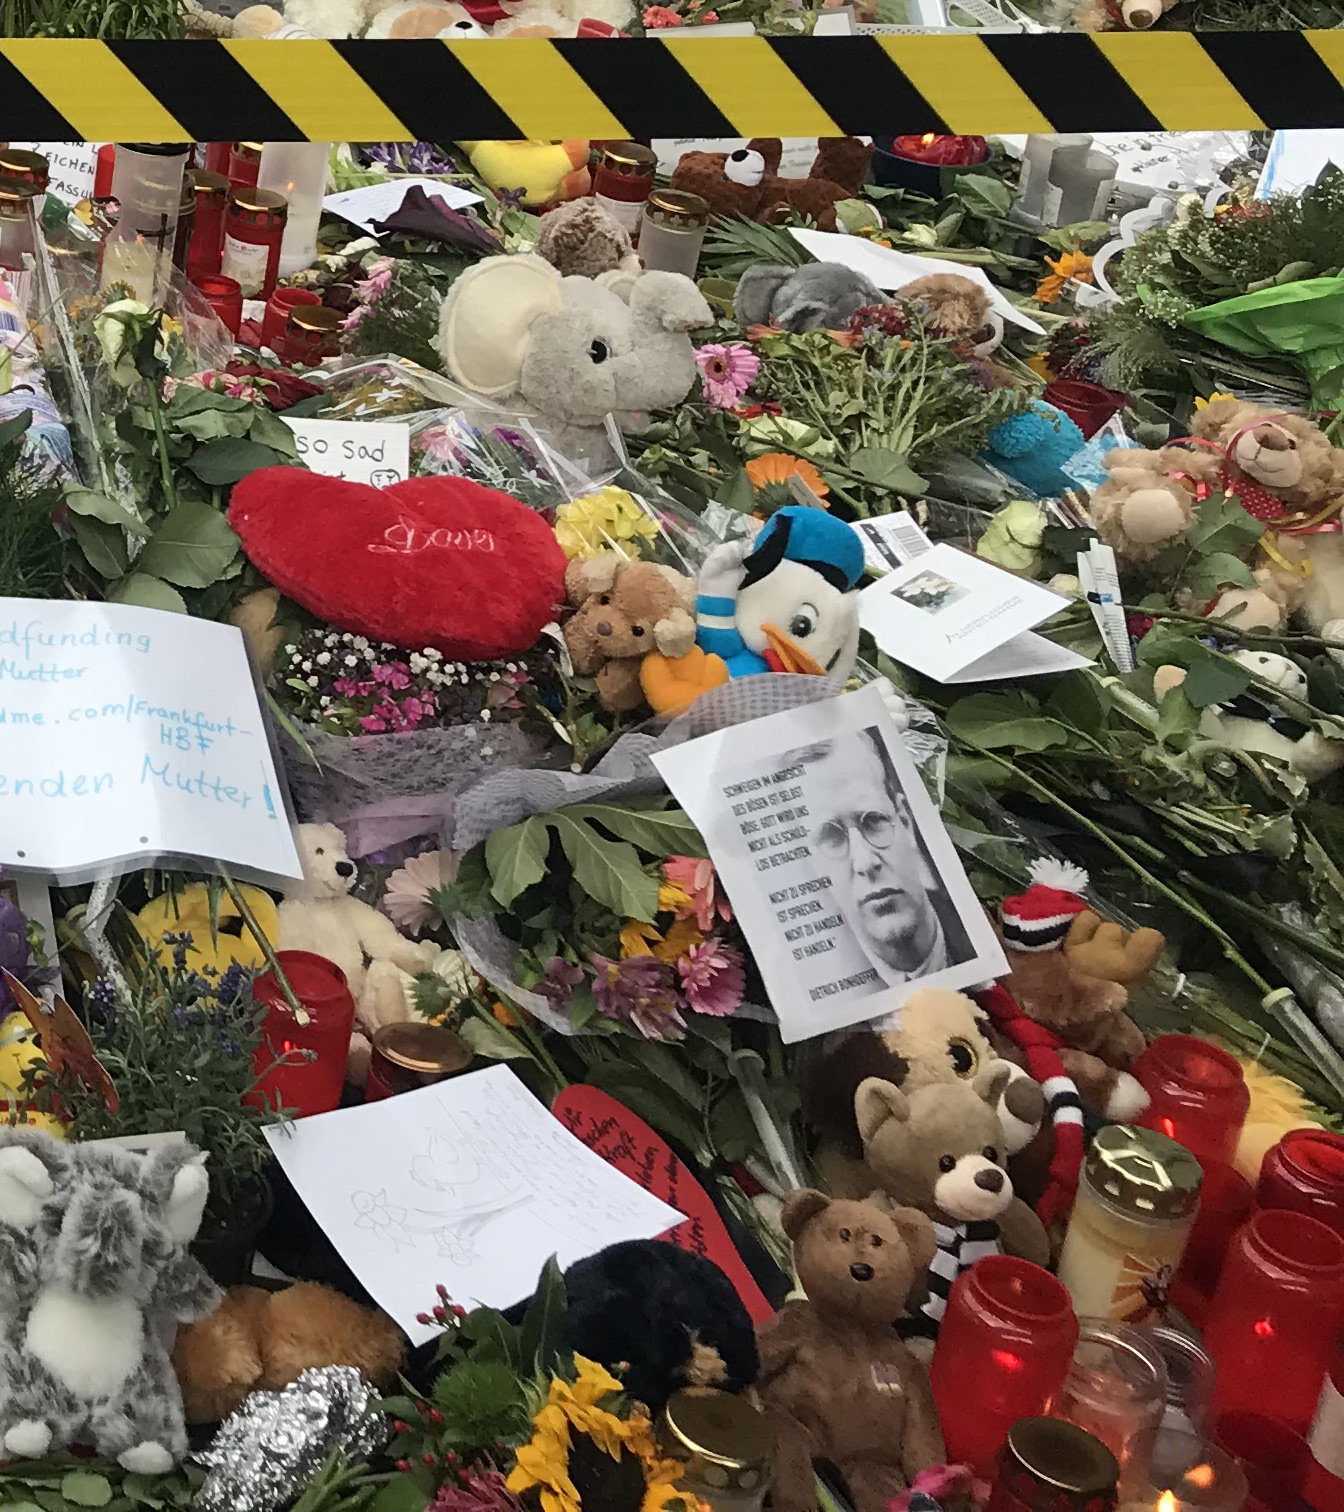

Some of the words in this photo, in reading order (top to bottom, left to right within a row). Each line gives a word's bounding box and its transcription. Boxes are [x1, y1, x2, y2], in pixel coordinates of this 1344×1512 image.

[723, 778, 762, 799] SCHWEIGEN
[771, 764, 807, 785] ANGESICHT
[731, 802, 747, 817] DES
[745, 797, 770, 813] BÖSEN
[768, 792, 781, 805] IST
[779, 786, 805, 803] SELBST
[759, 814, 778, 829] GOTT
[776, 809, 796, 824] WIRD
[794, 804, 810, 819] UNS
[747, 836, 769, 853] NICHT
[768, 833, 783, 846] ALS
[755, 858, 771, 872] LOS
[769, 888, 790, 905] NICHT
[789, 886, 800, 899] ZU
[776, 909, 789, 923] IST
[784, 926, 805, 943] NICHT
[803, 924, 815, 936] ZU
[813, 914, 845, 933] HANDELN
[792, 947, 805, 961] IST
[808, 982, 840, 1001] DIETRICH
